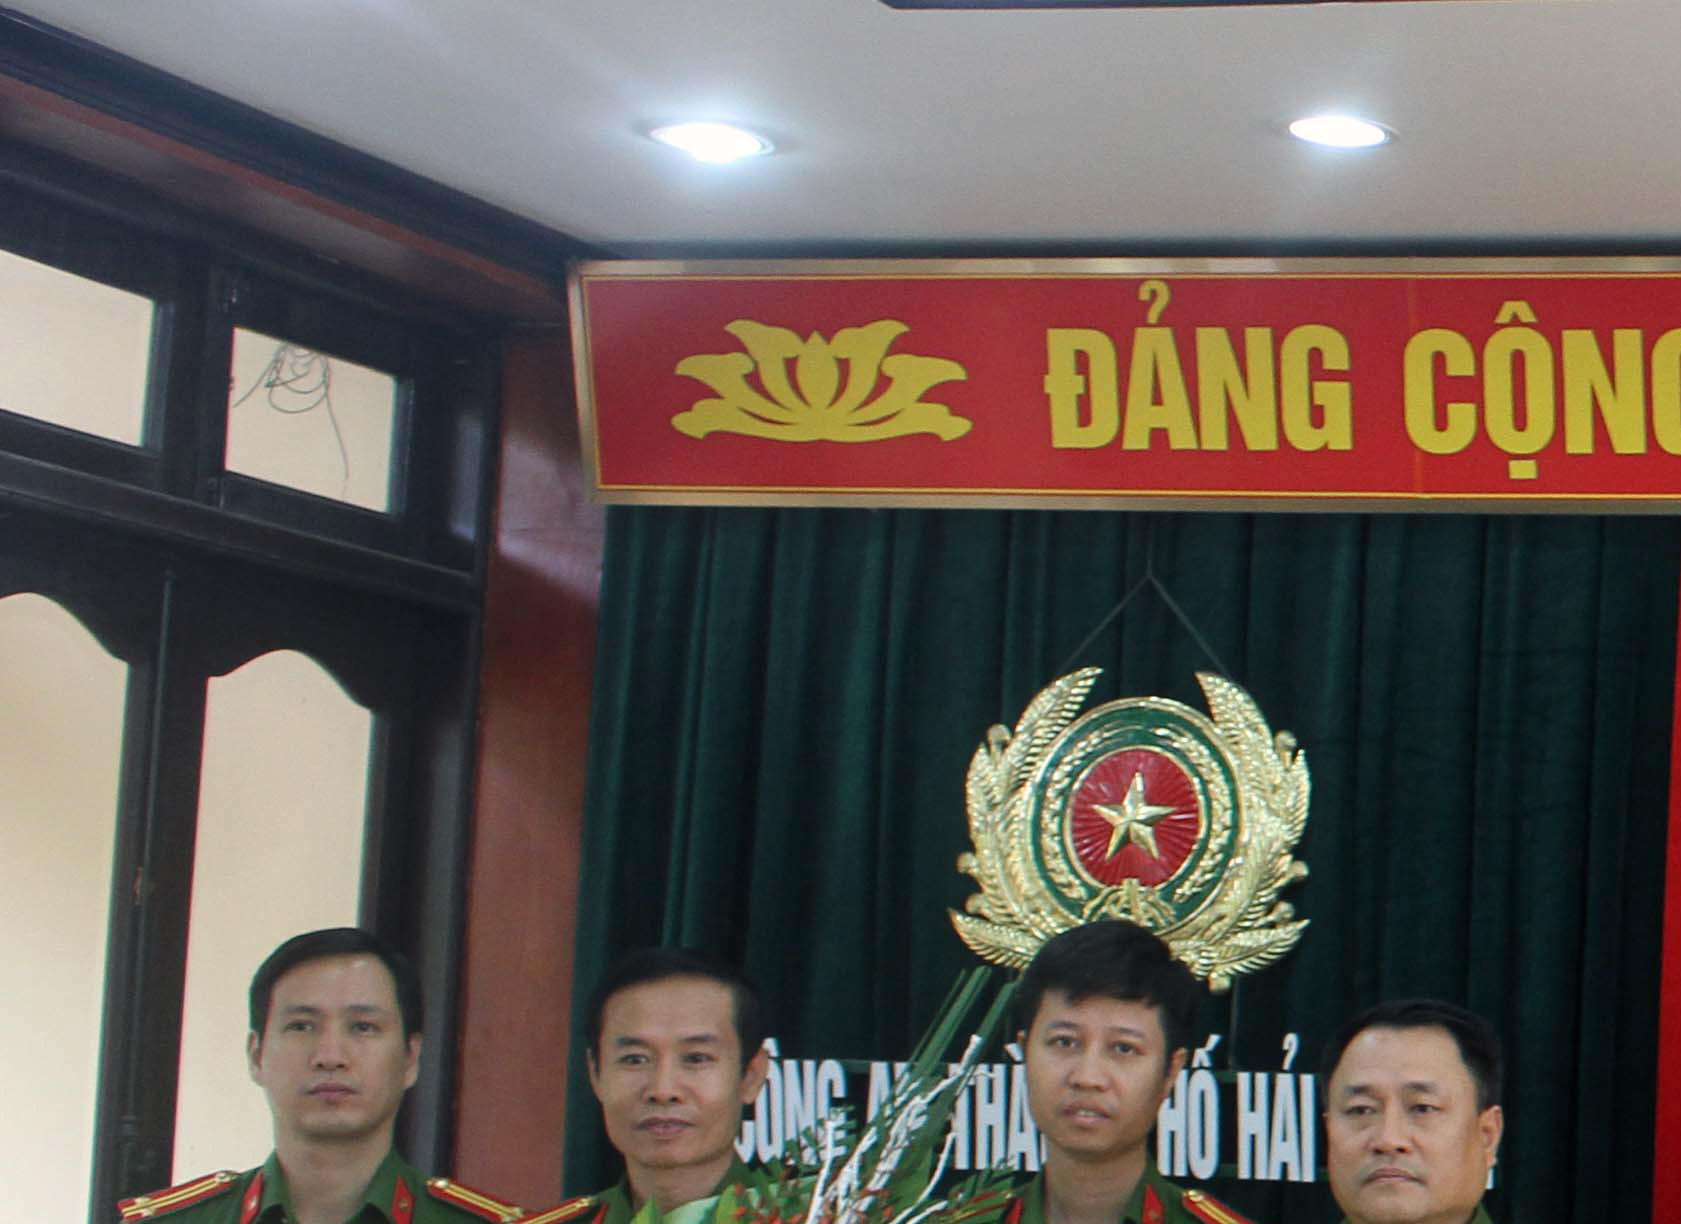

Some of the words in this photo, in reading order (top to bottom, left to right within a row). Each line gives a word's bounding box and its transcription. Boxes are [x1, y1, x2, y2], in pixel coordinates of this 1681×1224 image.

[1045, 276, 1353, 451] ĐẢNG
[1157, 1034, 1220, 1181] HỐ
[1236, 1032, 1316, 1183] HẢI
